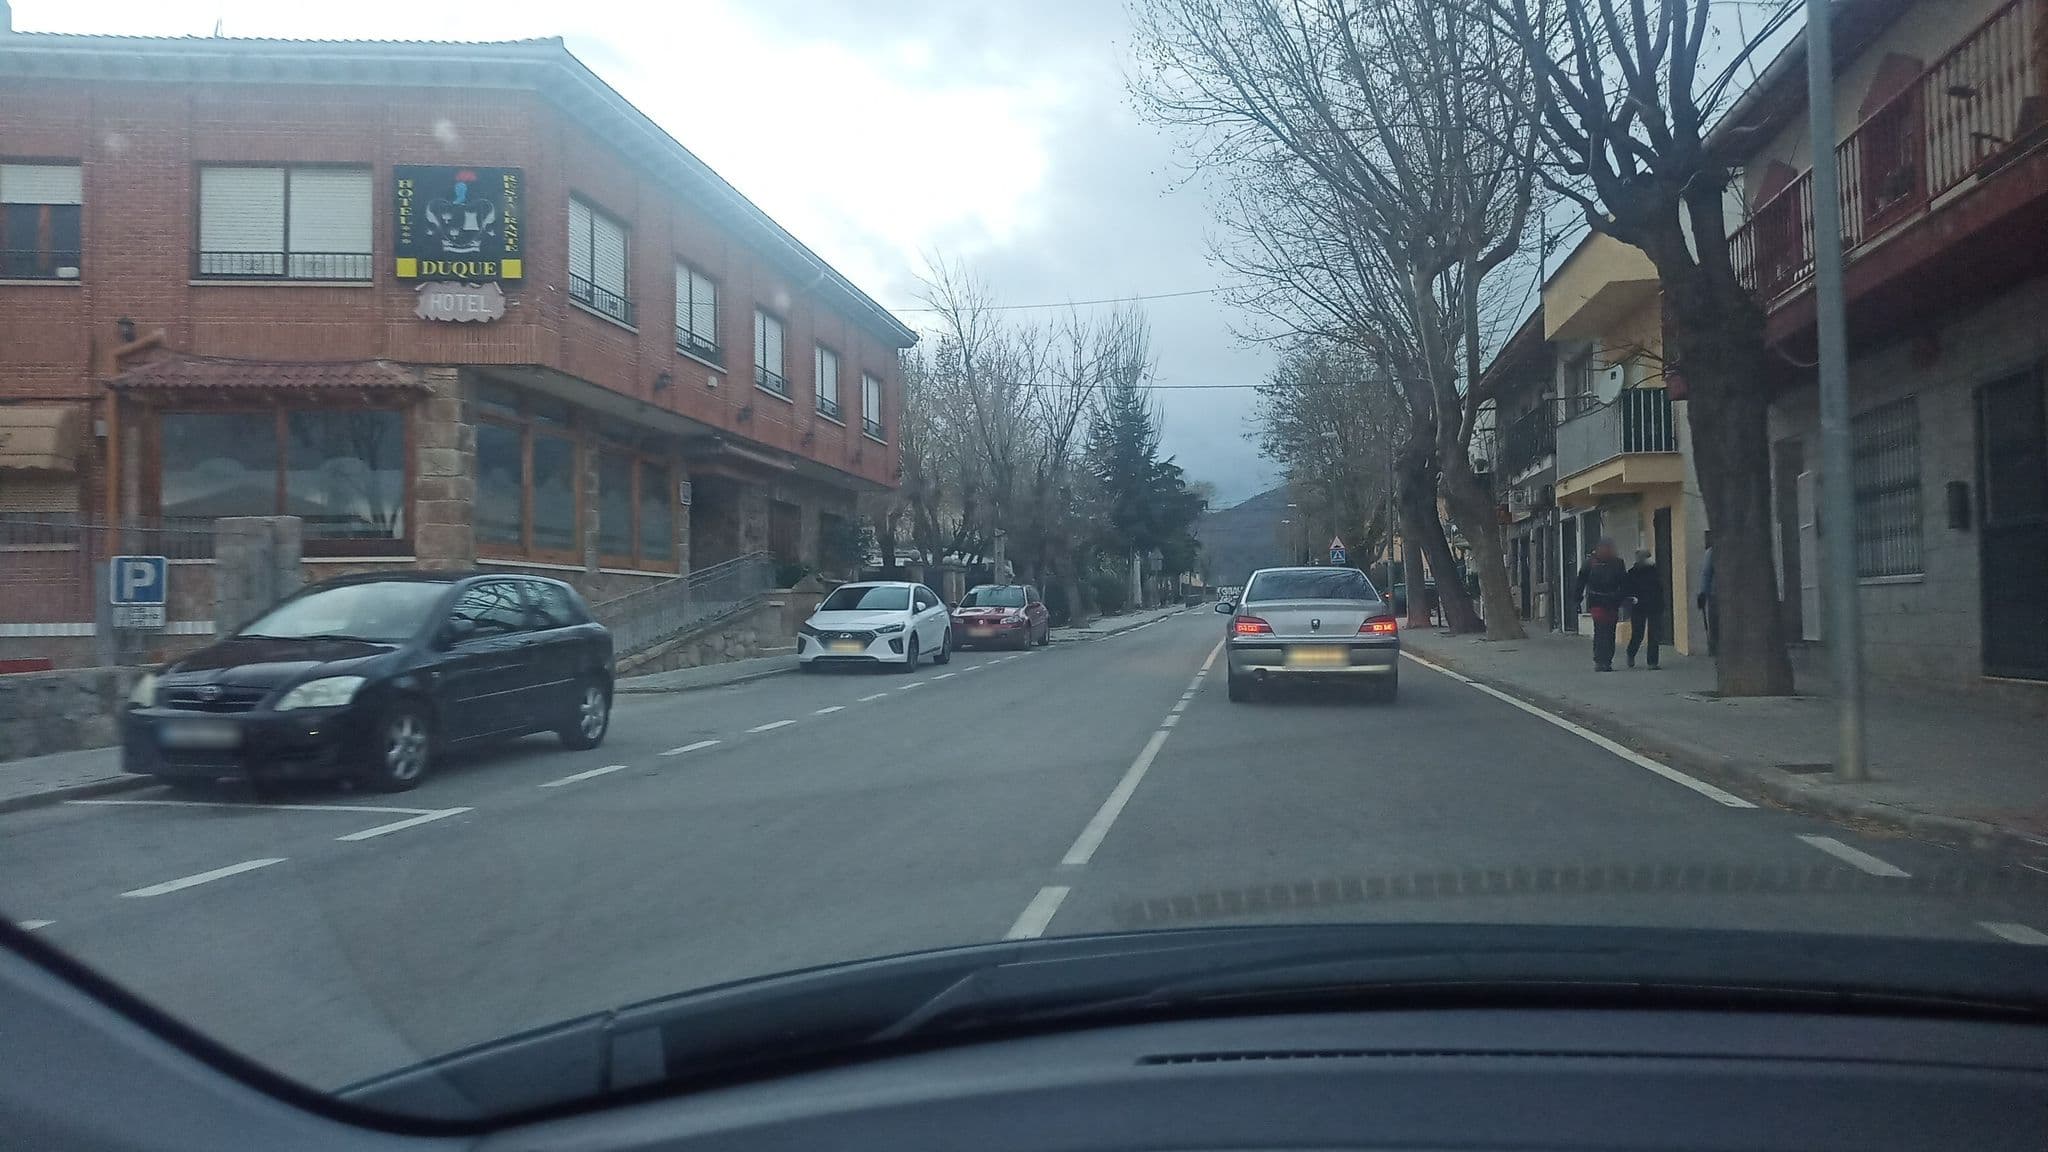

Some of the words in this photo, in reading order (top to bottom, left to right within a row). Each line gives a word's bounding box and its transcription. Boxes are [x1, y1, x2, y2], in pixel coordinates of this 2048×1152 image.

[398, 179, 414, 225] HOTEL
[422, 260, 497, 279] DUQUE
[431, 293, 493, 313] HOTEL
[123, 561, 155, 599] P
